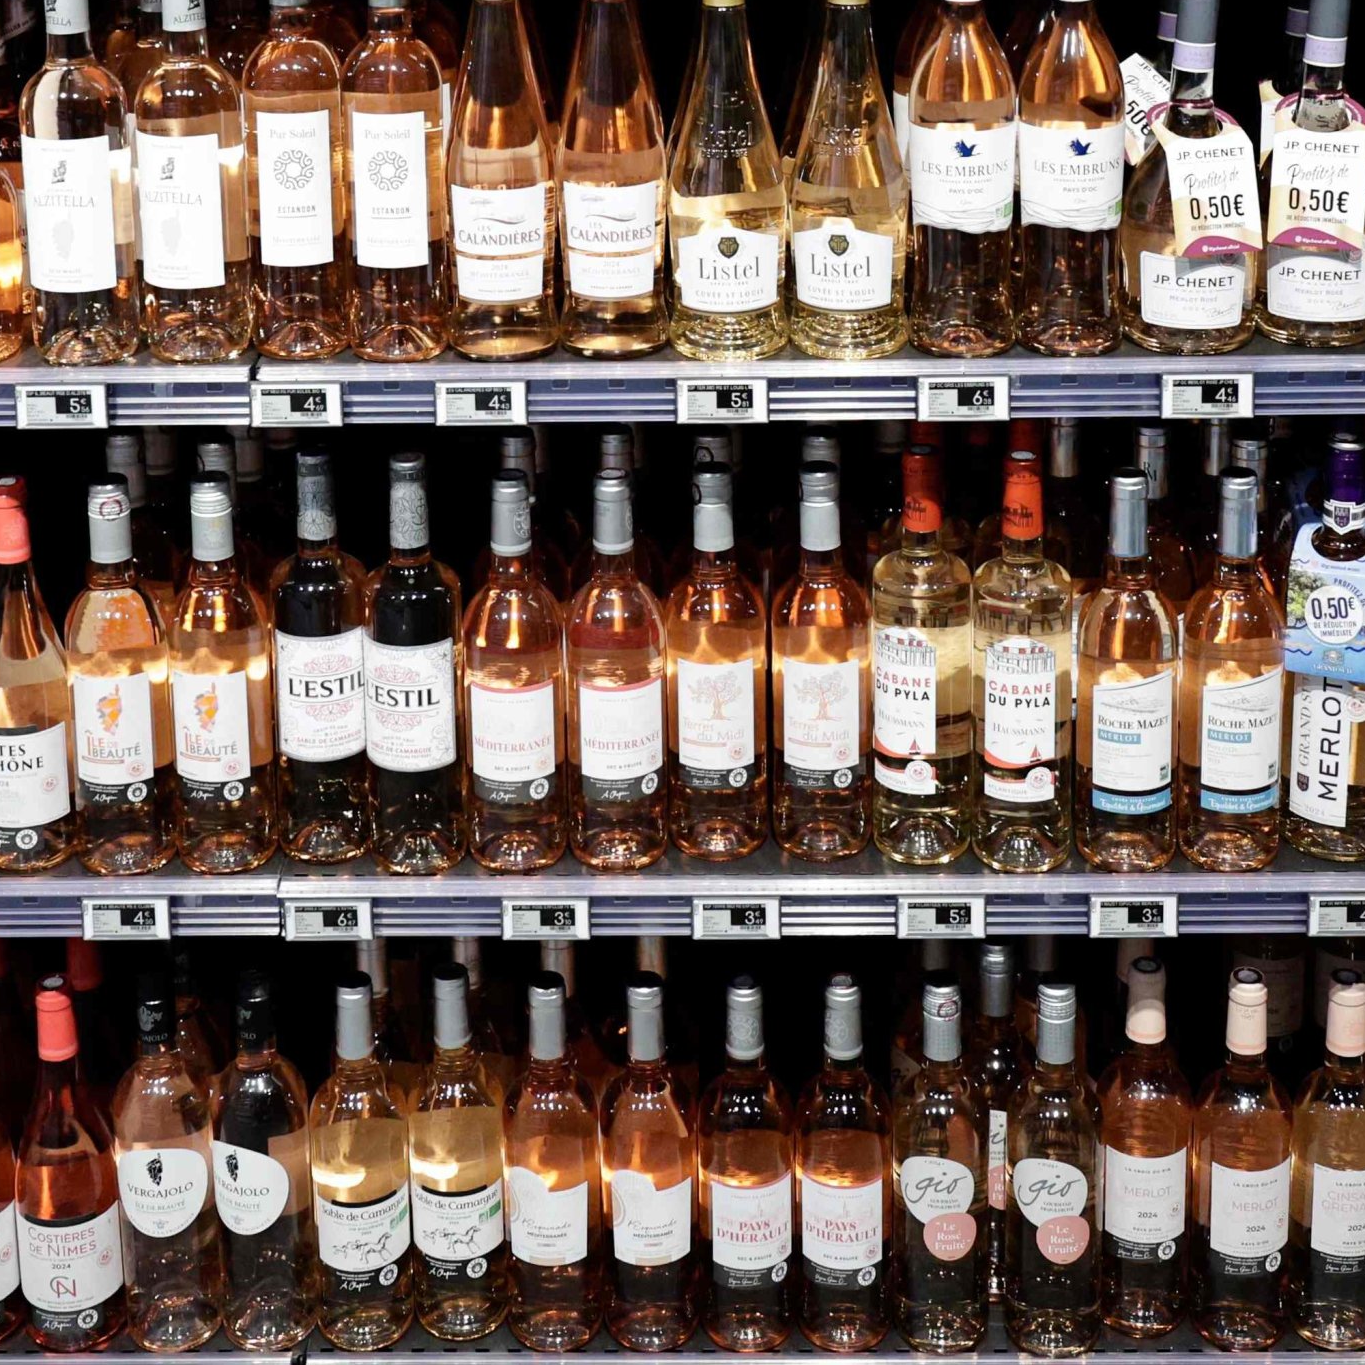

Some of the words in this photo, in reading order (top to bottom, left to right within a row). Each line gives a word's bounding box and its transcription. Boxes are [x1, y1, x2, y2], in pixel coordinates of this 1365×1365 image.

[289, 127, 316, 139] Soleil
[1176, 149, 1191, 161] JP.
[1195, 147, 1246, 160] CHENET
[921, 163, 941, 176] LES
[945, 160, 1009, 175] EMBRUNS
[1189, 191, 1247, 219] 0,50€
[1289, 189, 1349, 215] 0,50€
[458, 228, 541, 246] CALANDIÈRES
[699, 253, 762, 280] Listel
[1153, 276, 1170, 289] JP.
[1174, 275, 1235, 288] CHENET
[1310, 595, 1359, 622] 0,50€
[988, 681, 1052, 693] CABANE
[988, 696, 1005, 707] DU
[1011, 696, 1051, 709] PYLA
[473, 735, 551, 751] MÉDITERRANÉE
[1317, 677, 1345, 803] MERLOT
[127, 1180, 194, 1199] VERGAJOLO
[716, 1222, 790, 1243] D'HÉRAULT
[738, 1219, 771, 1232] PAYS
